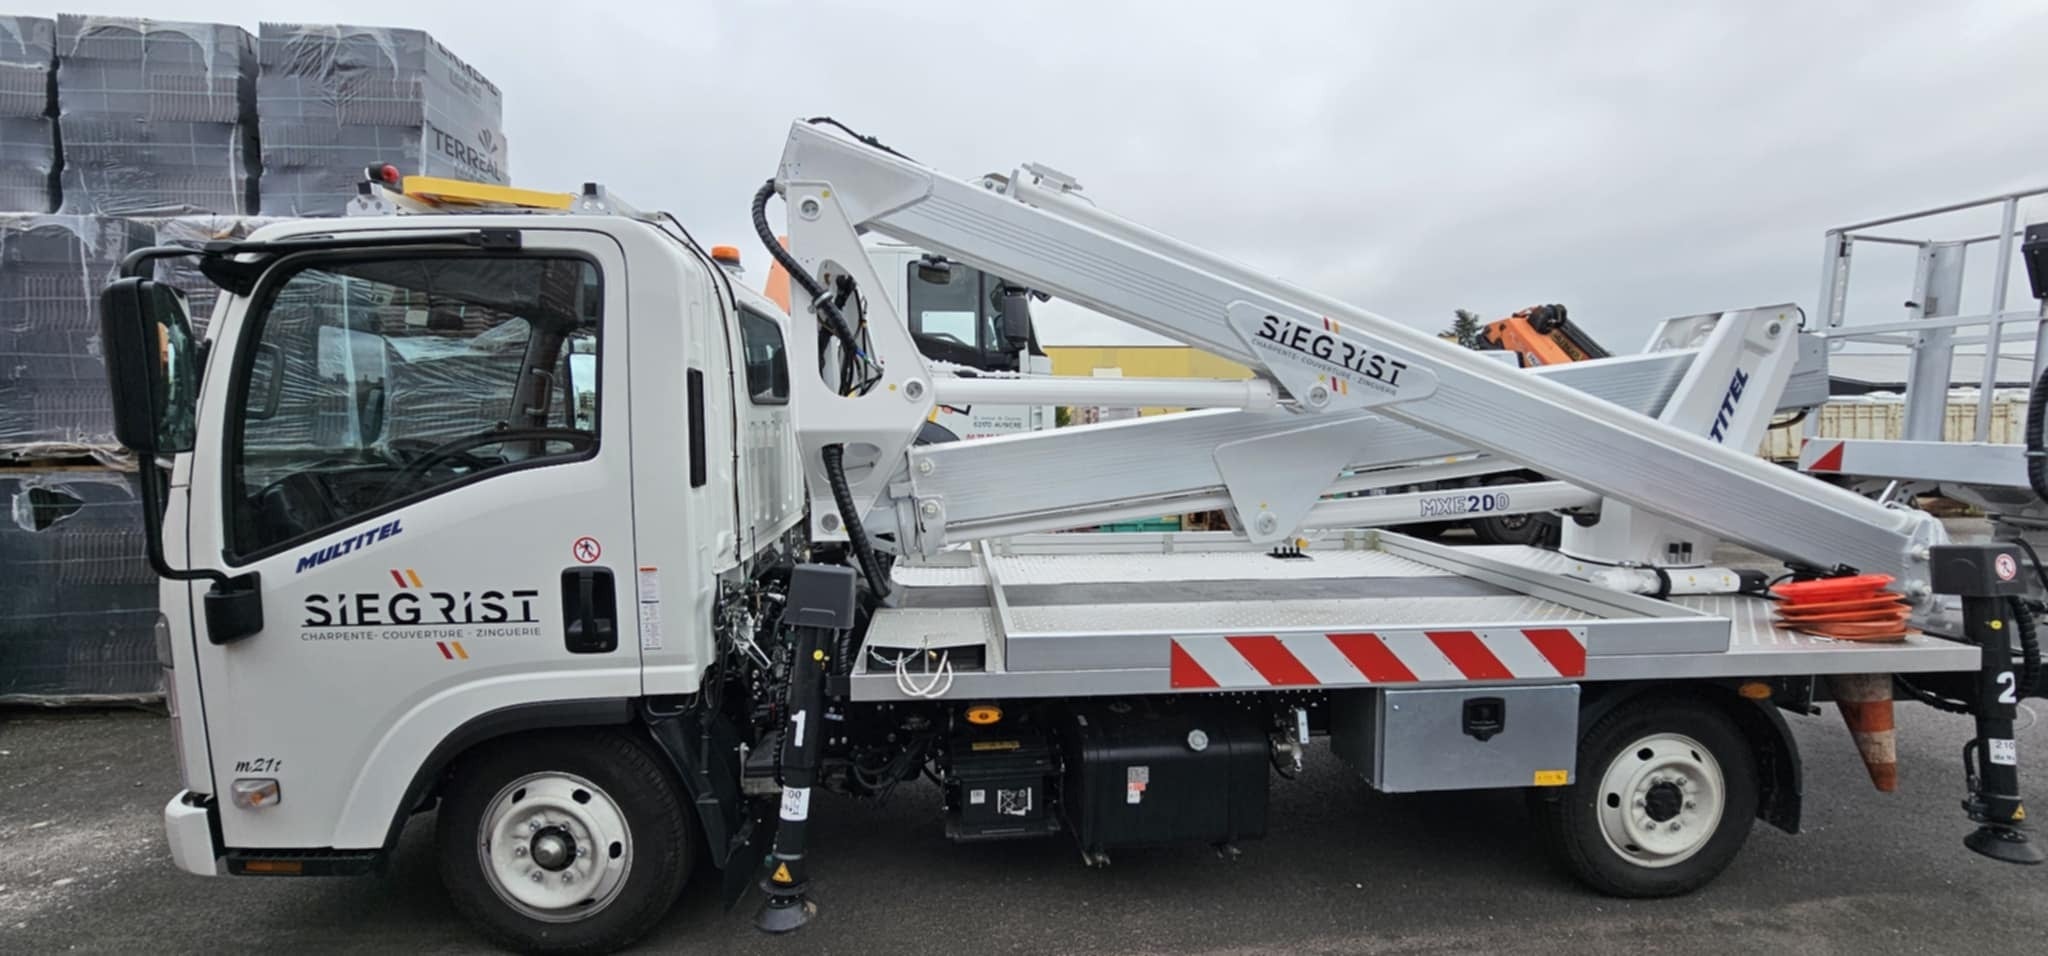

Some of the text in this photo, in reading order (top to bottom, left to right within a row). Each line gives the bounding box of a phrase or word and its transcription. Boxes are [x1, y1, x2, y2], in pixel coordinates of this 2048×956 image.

[432, 126, 501, 181] TERREAL
[1258, 315, 1407, 386] SIEGRIST
[1707, 367, 1749, 444] TITEL
[295, 519, 403, 574] MULTITEL
[303, 589, 540, 627] SIEGRIST
[382, 629, 464, 640] COUVERTURE
[475, 627, 542, 638] ZINGUERIE
[1996, 671, 2017, 704] 2
[790, 710, 807, 747] 1
